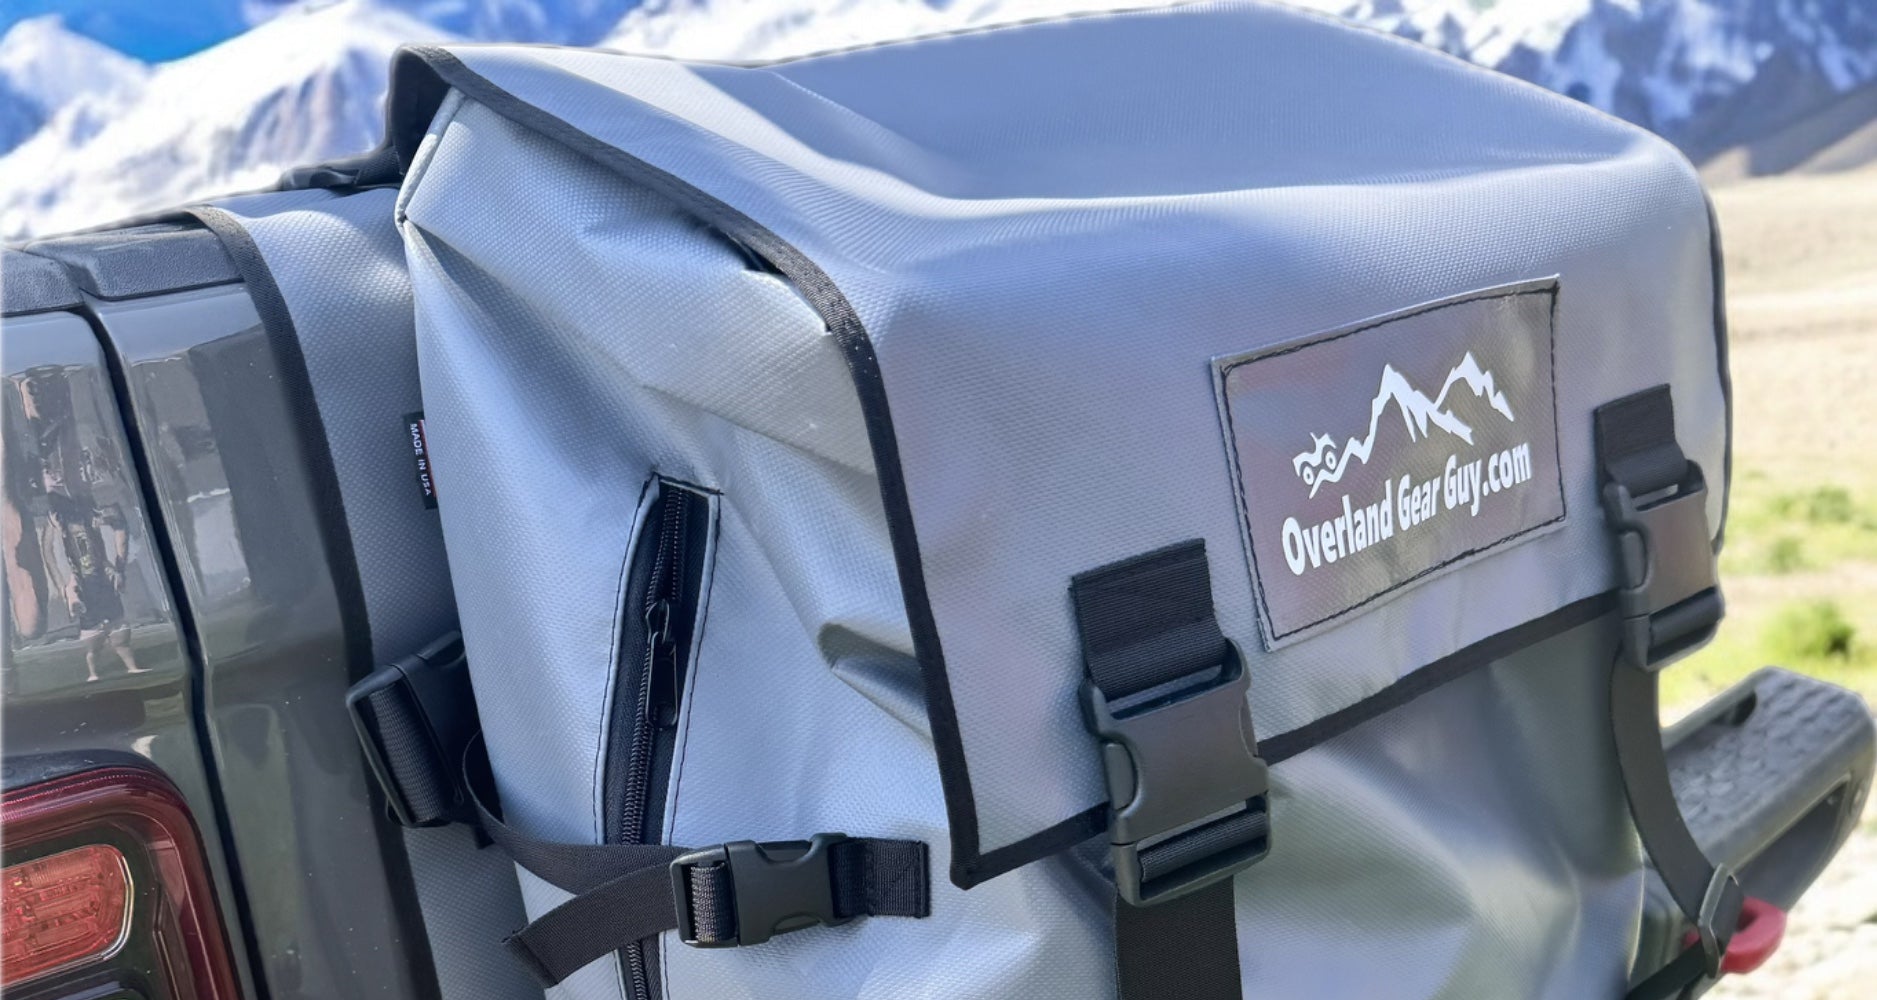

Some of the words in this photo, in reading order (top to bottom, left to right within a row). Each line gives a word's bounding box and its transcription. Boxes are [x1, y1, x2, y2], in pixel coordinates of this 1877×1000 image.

[410, 423, 423, 455] MADE
[418, 459, 426, 470] IN
[420, 474, 432, 496] USA
[1282, 477, 1394, 576] Overland
[1397, 474, 1442, 531] Gear
[1443, 442, 1532, 517] Guy.com
